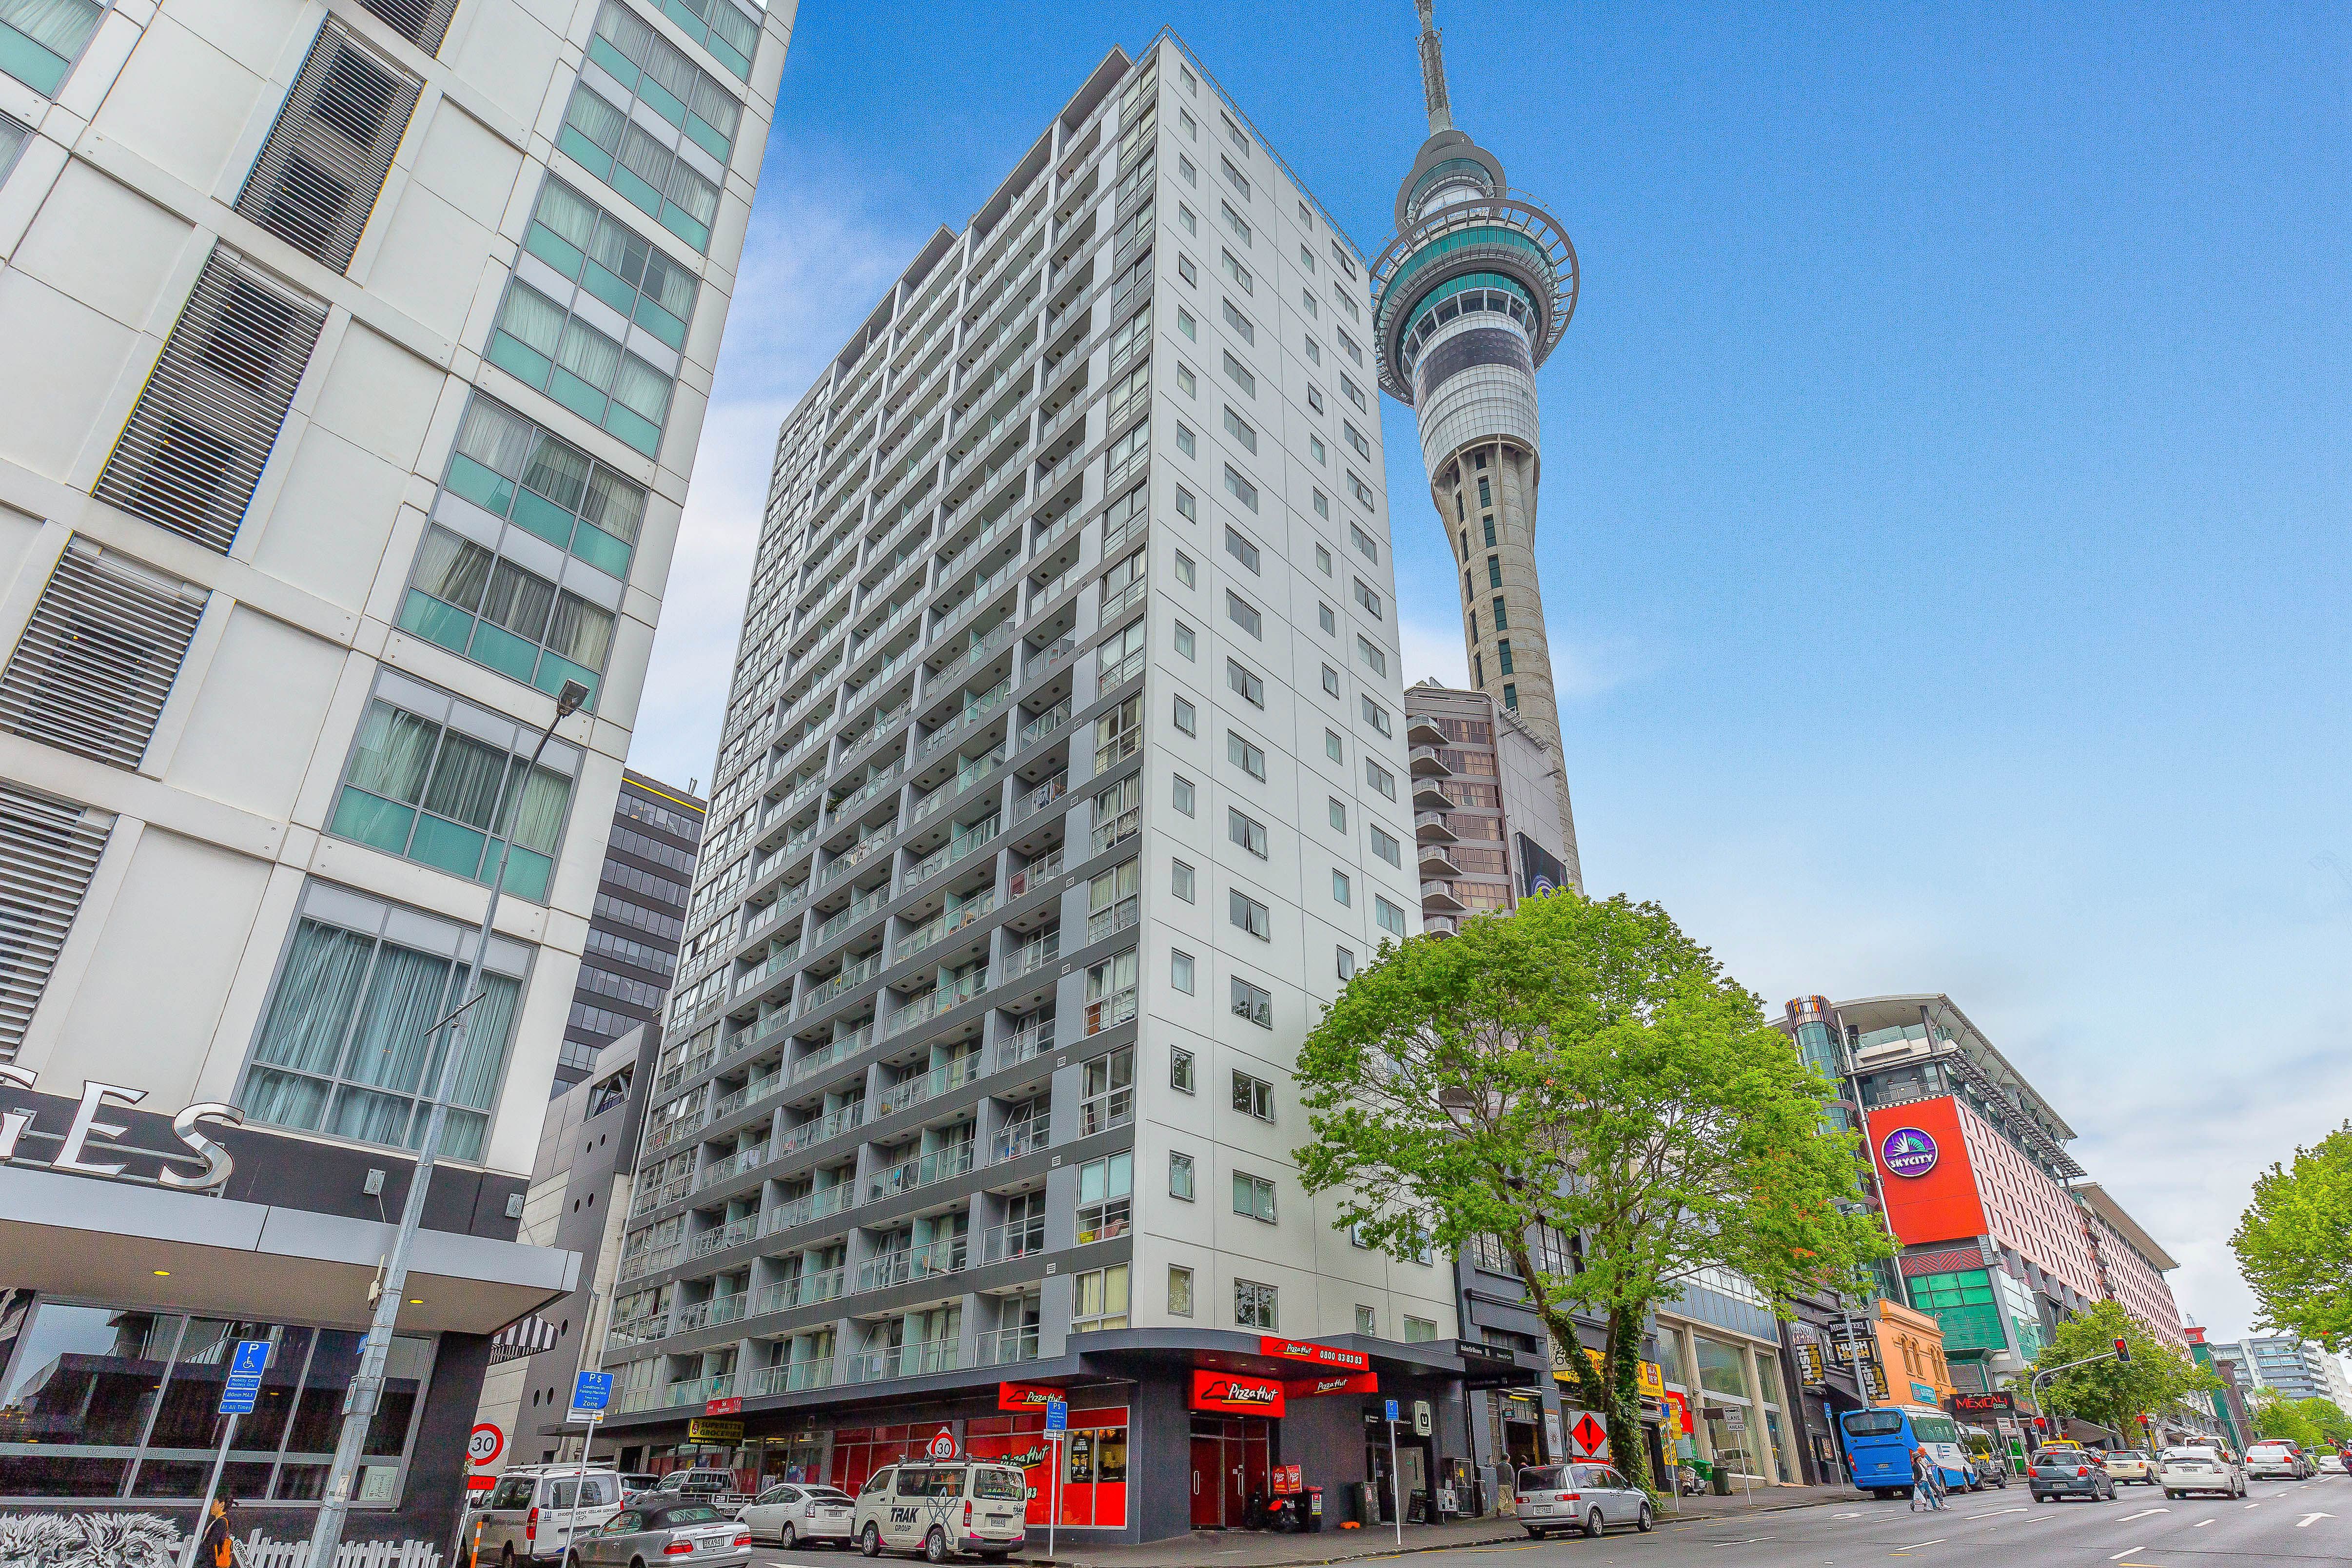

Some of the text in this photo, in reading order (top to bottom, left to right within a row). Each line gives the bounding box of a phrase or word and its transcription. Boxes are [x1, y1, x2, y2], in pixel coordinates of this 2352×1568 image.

[1890, 1154, 1933, 1168] SKYCITY
[248, 1343, 259, 1354] P
[1286, 1344, 1362, 1364] Pizza Hut 0800 83 83 83
[1229, 1383, 1278, 1401] Pizza Hut
[1317, 1381, 1333, 1391] Pizza
[1026, 1392, 1063, 1402] Pizza Hut
[701, 1421, 742, 1430] SUPERETTE
[471, 1436, 494, 1452] 30
[937, 1443, 950, 1454] 30
[1027, 1445, 1050, 1464] Hut
[890, 1507, 921, 1523] TRAK
[704, 1537, 724, 1548] BKA941
